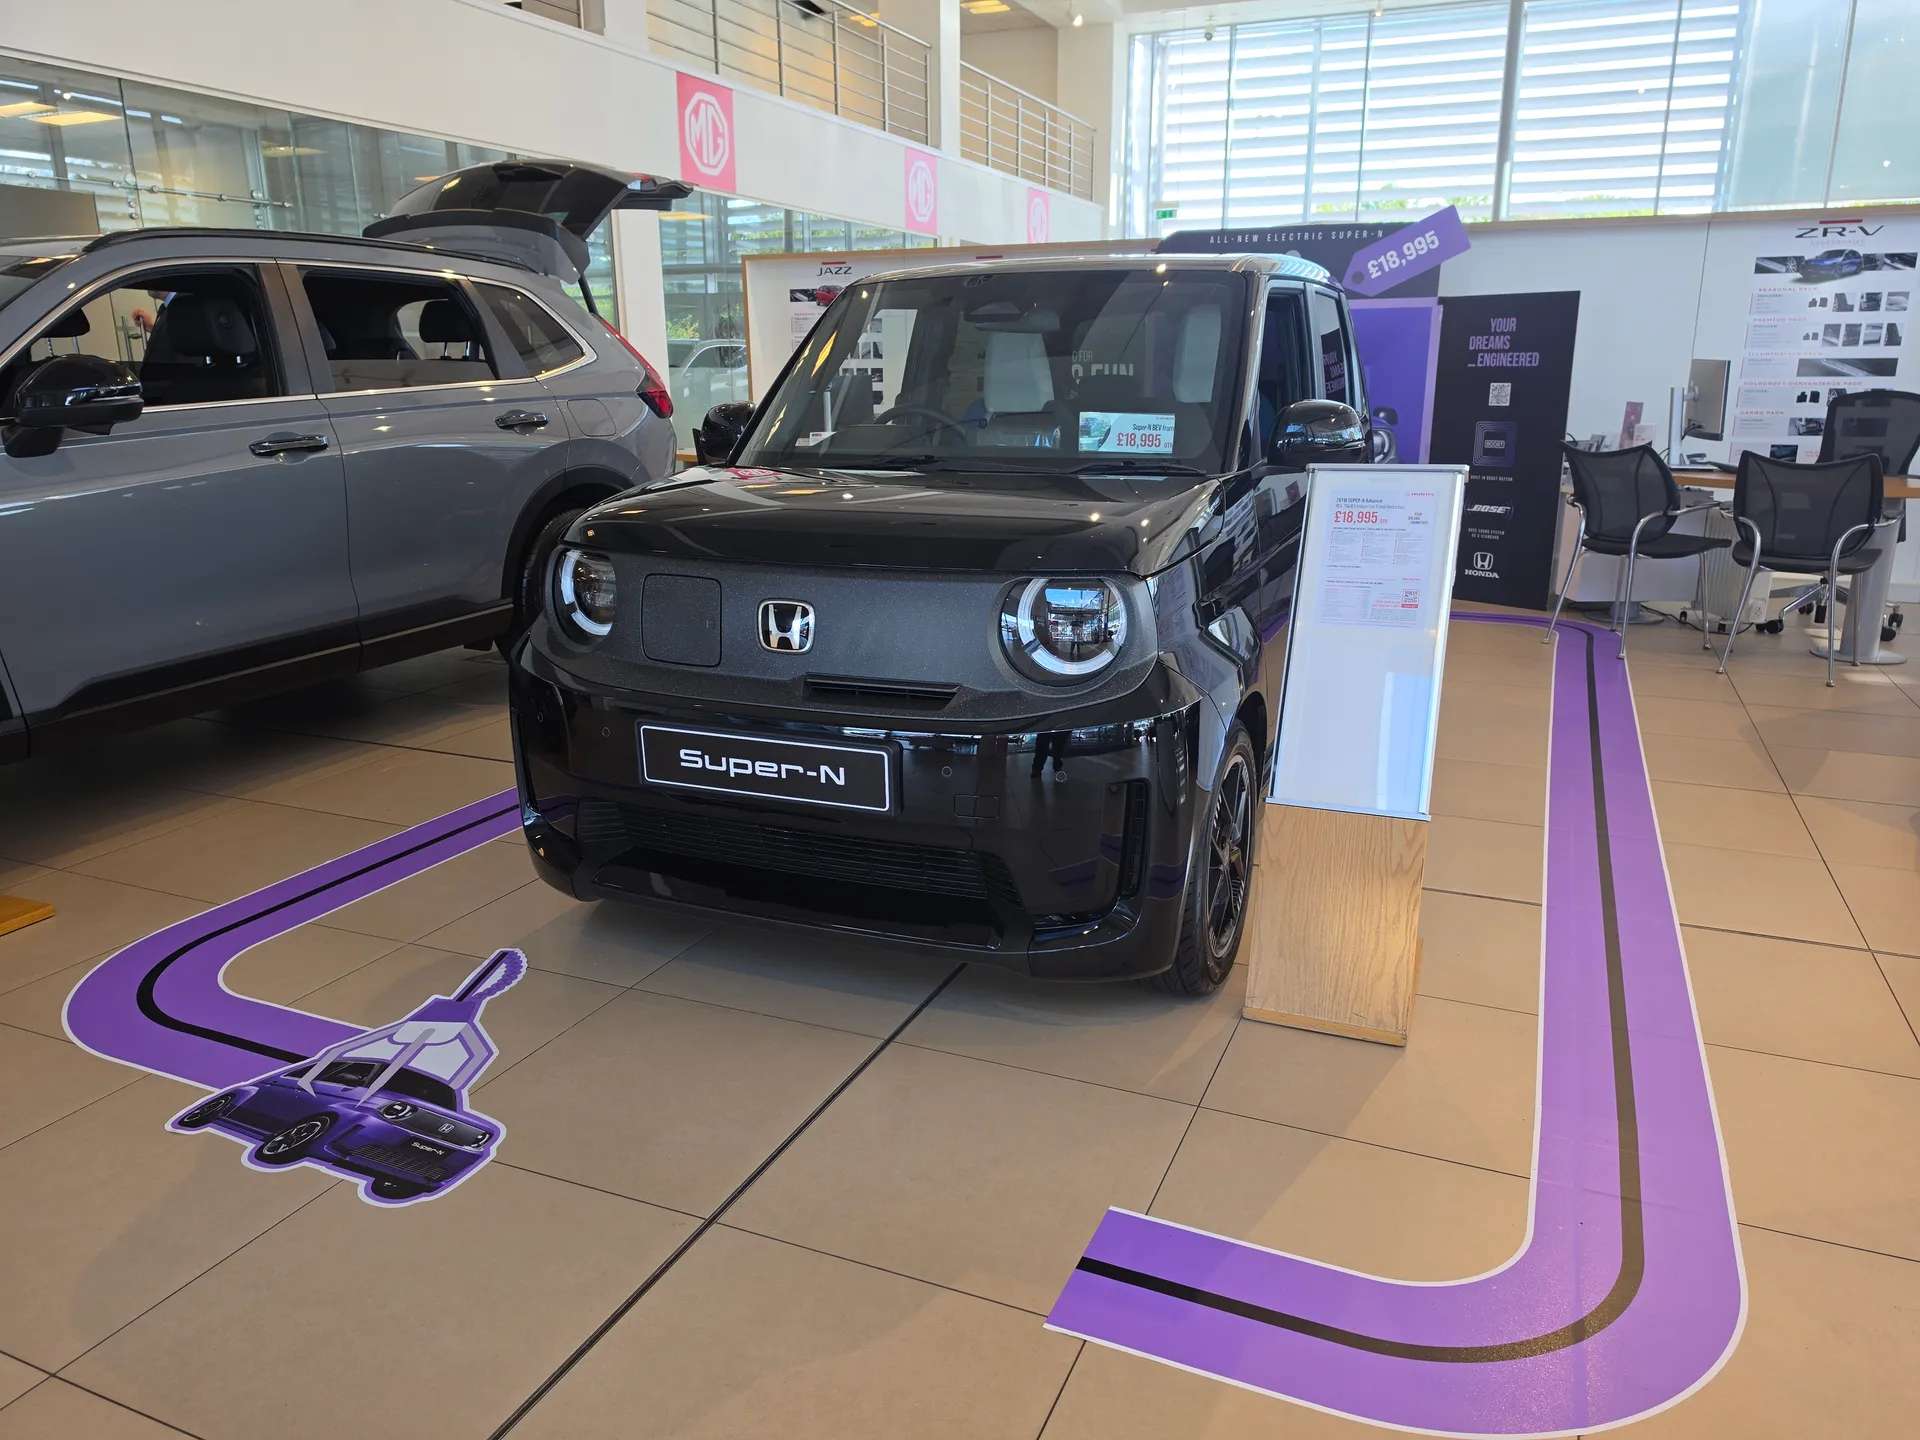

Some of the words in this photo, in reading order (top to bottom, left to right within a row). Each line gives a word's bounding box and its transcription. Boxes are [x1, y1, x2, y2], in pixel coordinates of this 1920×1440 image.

[1209, 233, 1259, 245] ALL-NEW
[1266, 231, 1324, 243] ELECTRIC
[1330, 229, 1384, 241] SUPER-N
[1794, 224, 1885, 239] ZR-V
[1366, 230, 1441, 280] £18,995
[816, 265, 854, 277] JAZZ
[1490, 317, 1517, 333] YOUR
[1468, 335, 1511, 351] DREAMS
[1116, 432, 1162, 450] £18,995
[1464, 568, 1500, 579] HONDA
[679, 748, 846, 787] Super-N
